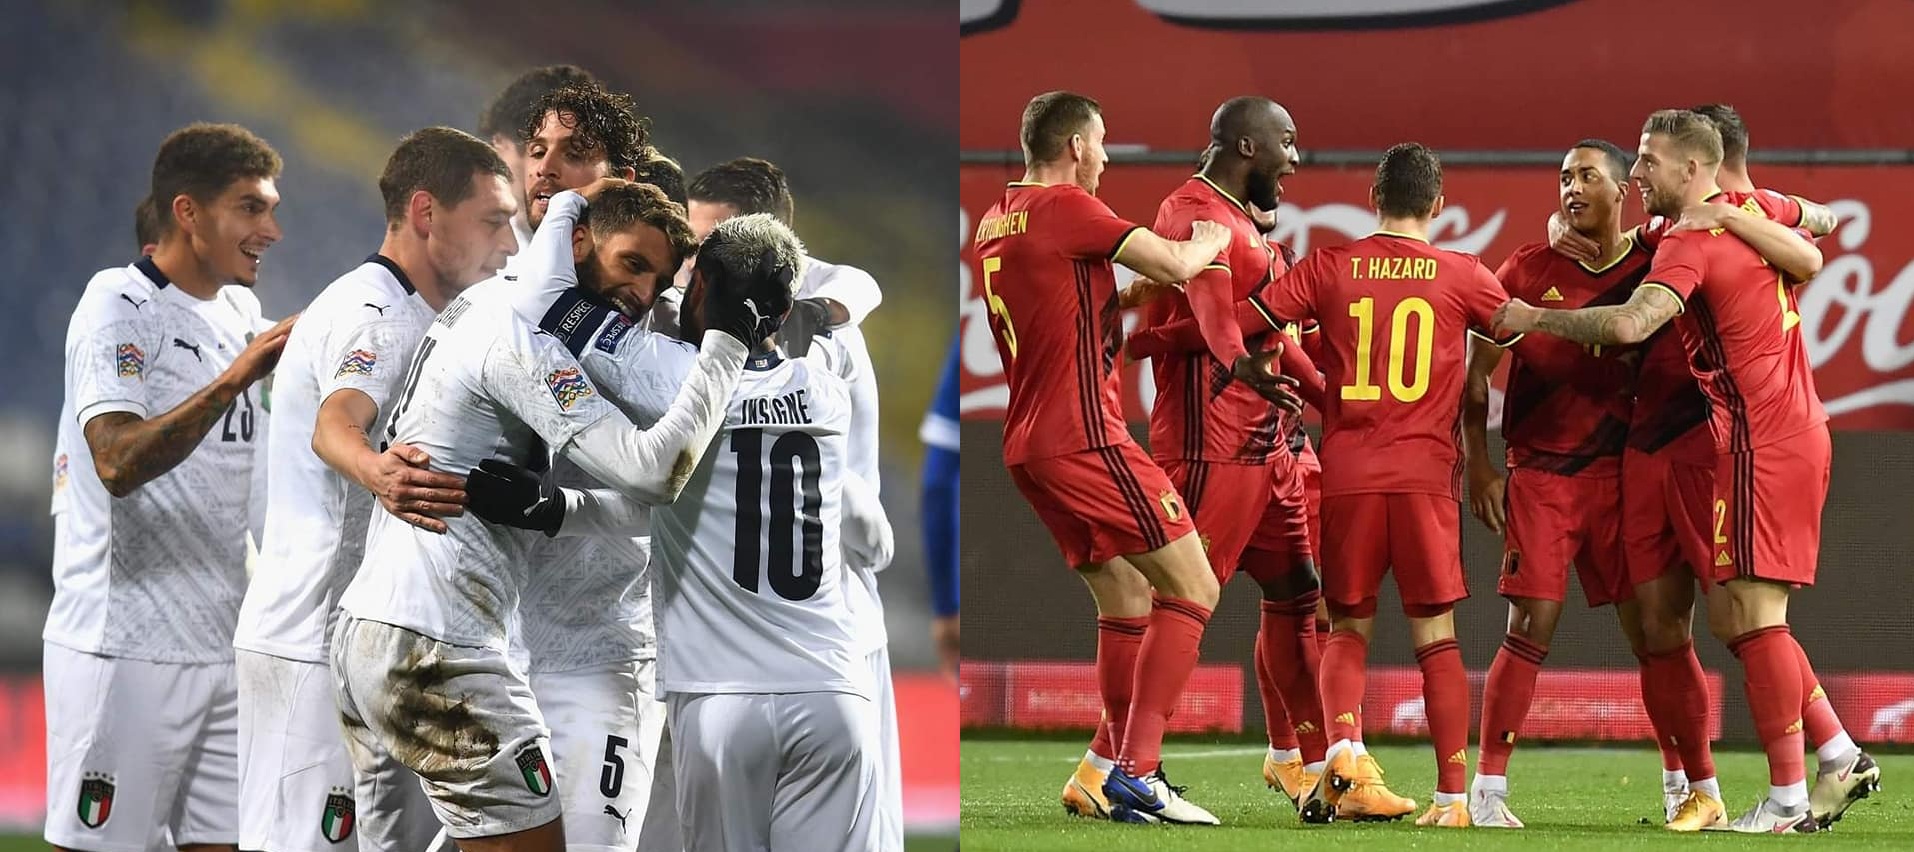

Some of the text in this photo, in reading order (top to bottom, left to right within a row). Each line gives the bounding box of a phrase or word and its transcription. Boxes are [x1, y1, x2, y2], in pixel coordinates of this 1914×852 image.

[983, 256, 1017, 359] 5
[1351, 257, 1437, 280] T. HAZARD
[1341, 297, 1434, 403] 10
[741, 390, 813, 425] INSIGNE
[730, 427, 824, 601] 10
[600, 735, 629, 799] 5
